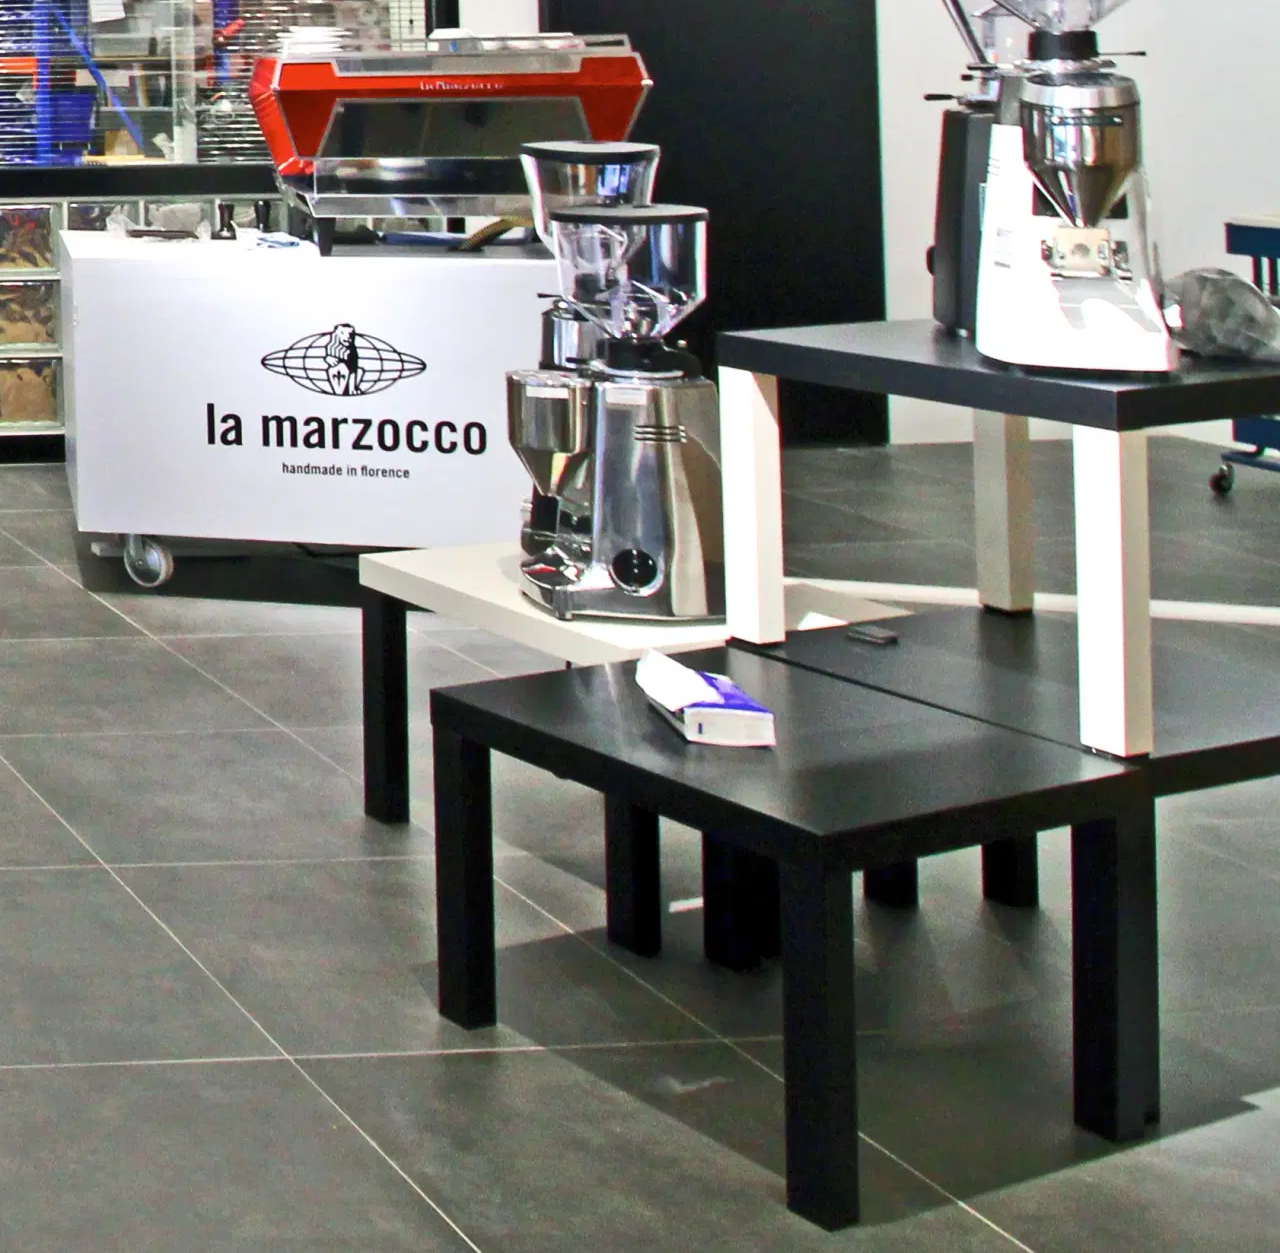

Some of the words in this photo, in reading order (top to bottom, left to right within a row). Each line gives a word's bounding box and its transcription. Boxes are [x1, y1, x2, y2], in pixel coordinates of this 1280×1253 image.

[206, 403, 243, 446] la
[262, 414, 487, 455] marzocco
[282, 462, 342, 476] handmade
[347, 464, 357, 476] in
[360, 465, 410, 479] florence
